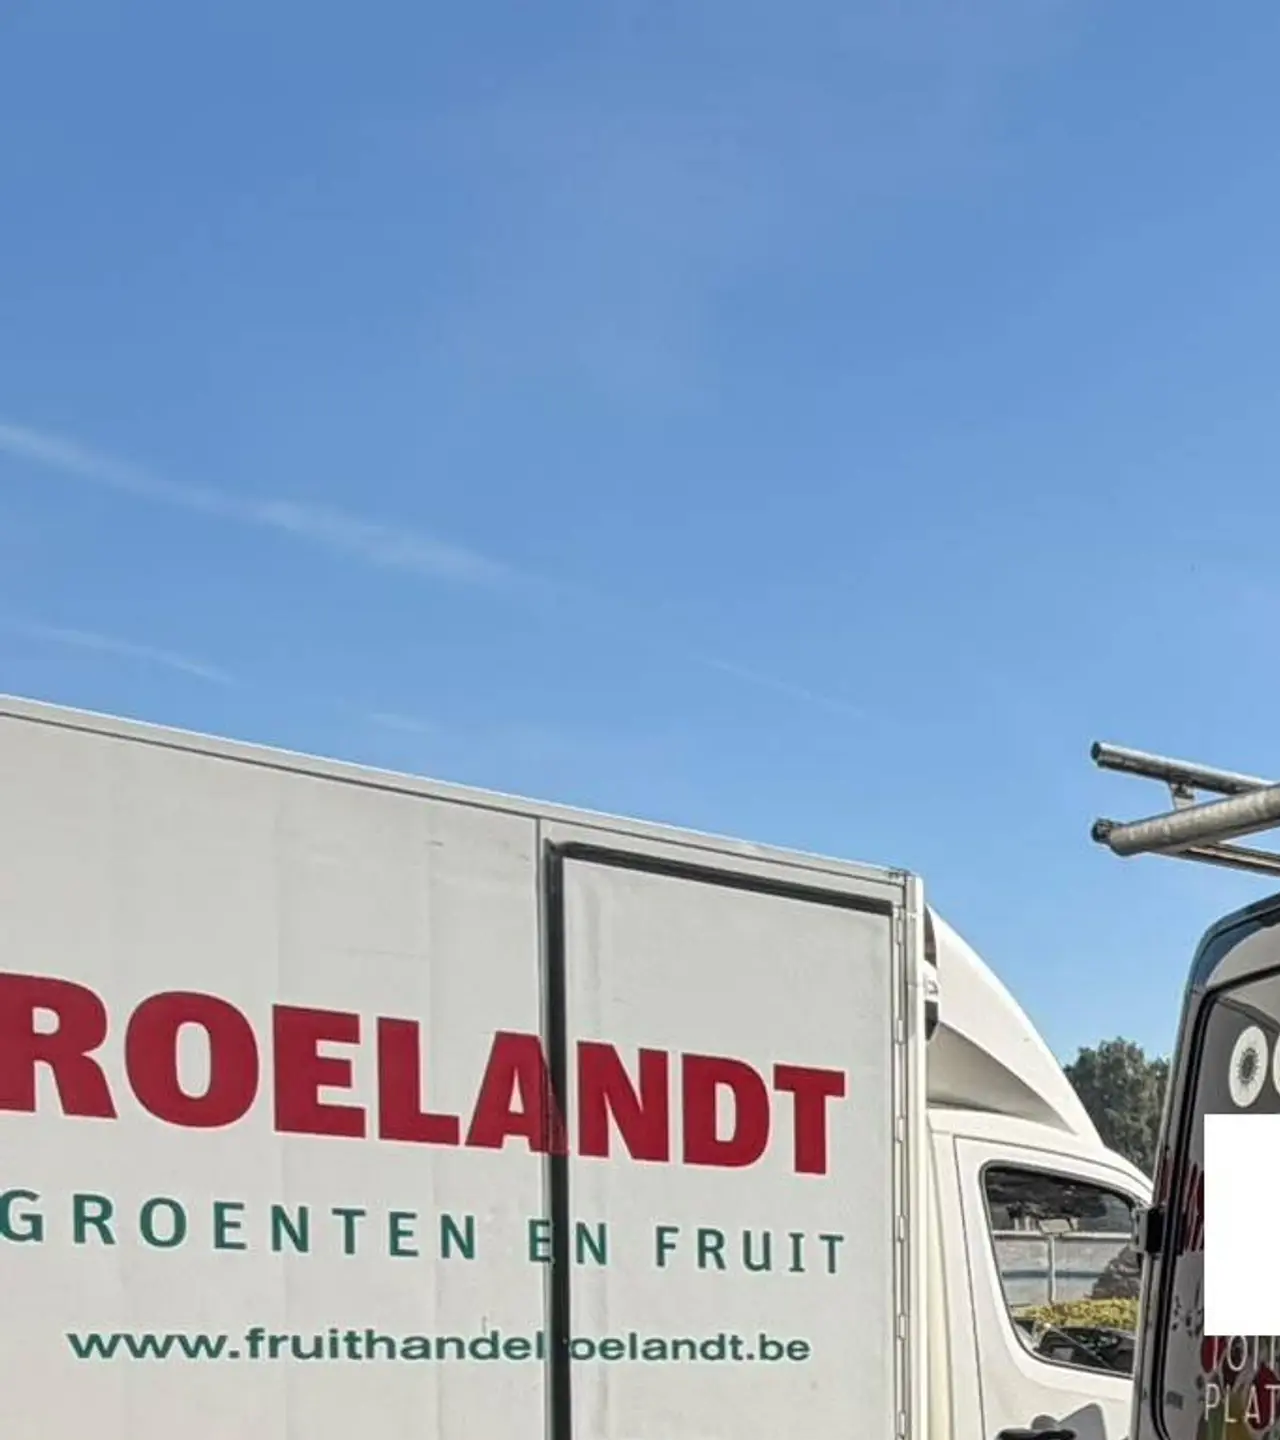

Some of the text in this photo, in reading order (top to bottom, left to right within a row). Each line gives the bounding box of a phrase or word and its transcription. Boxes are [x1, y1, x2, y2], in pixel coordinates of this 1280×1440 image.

[0, 971, 846, 1175] ROELANDT
[0, 1188, 845, 1274] GROENTEN EN FRUIT
[66, 1326, 811, 1363] www.fruithandeloelandt.be
